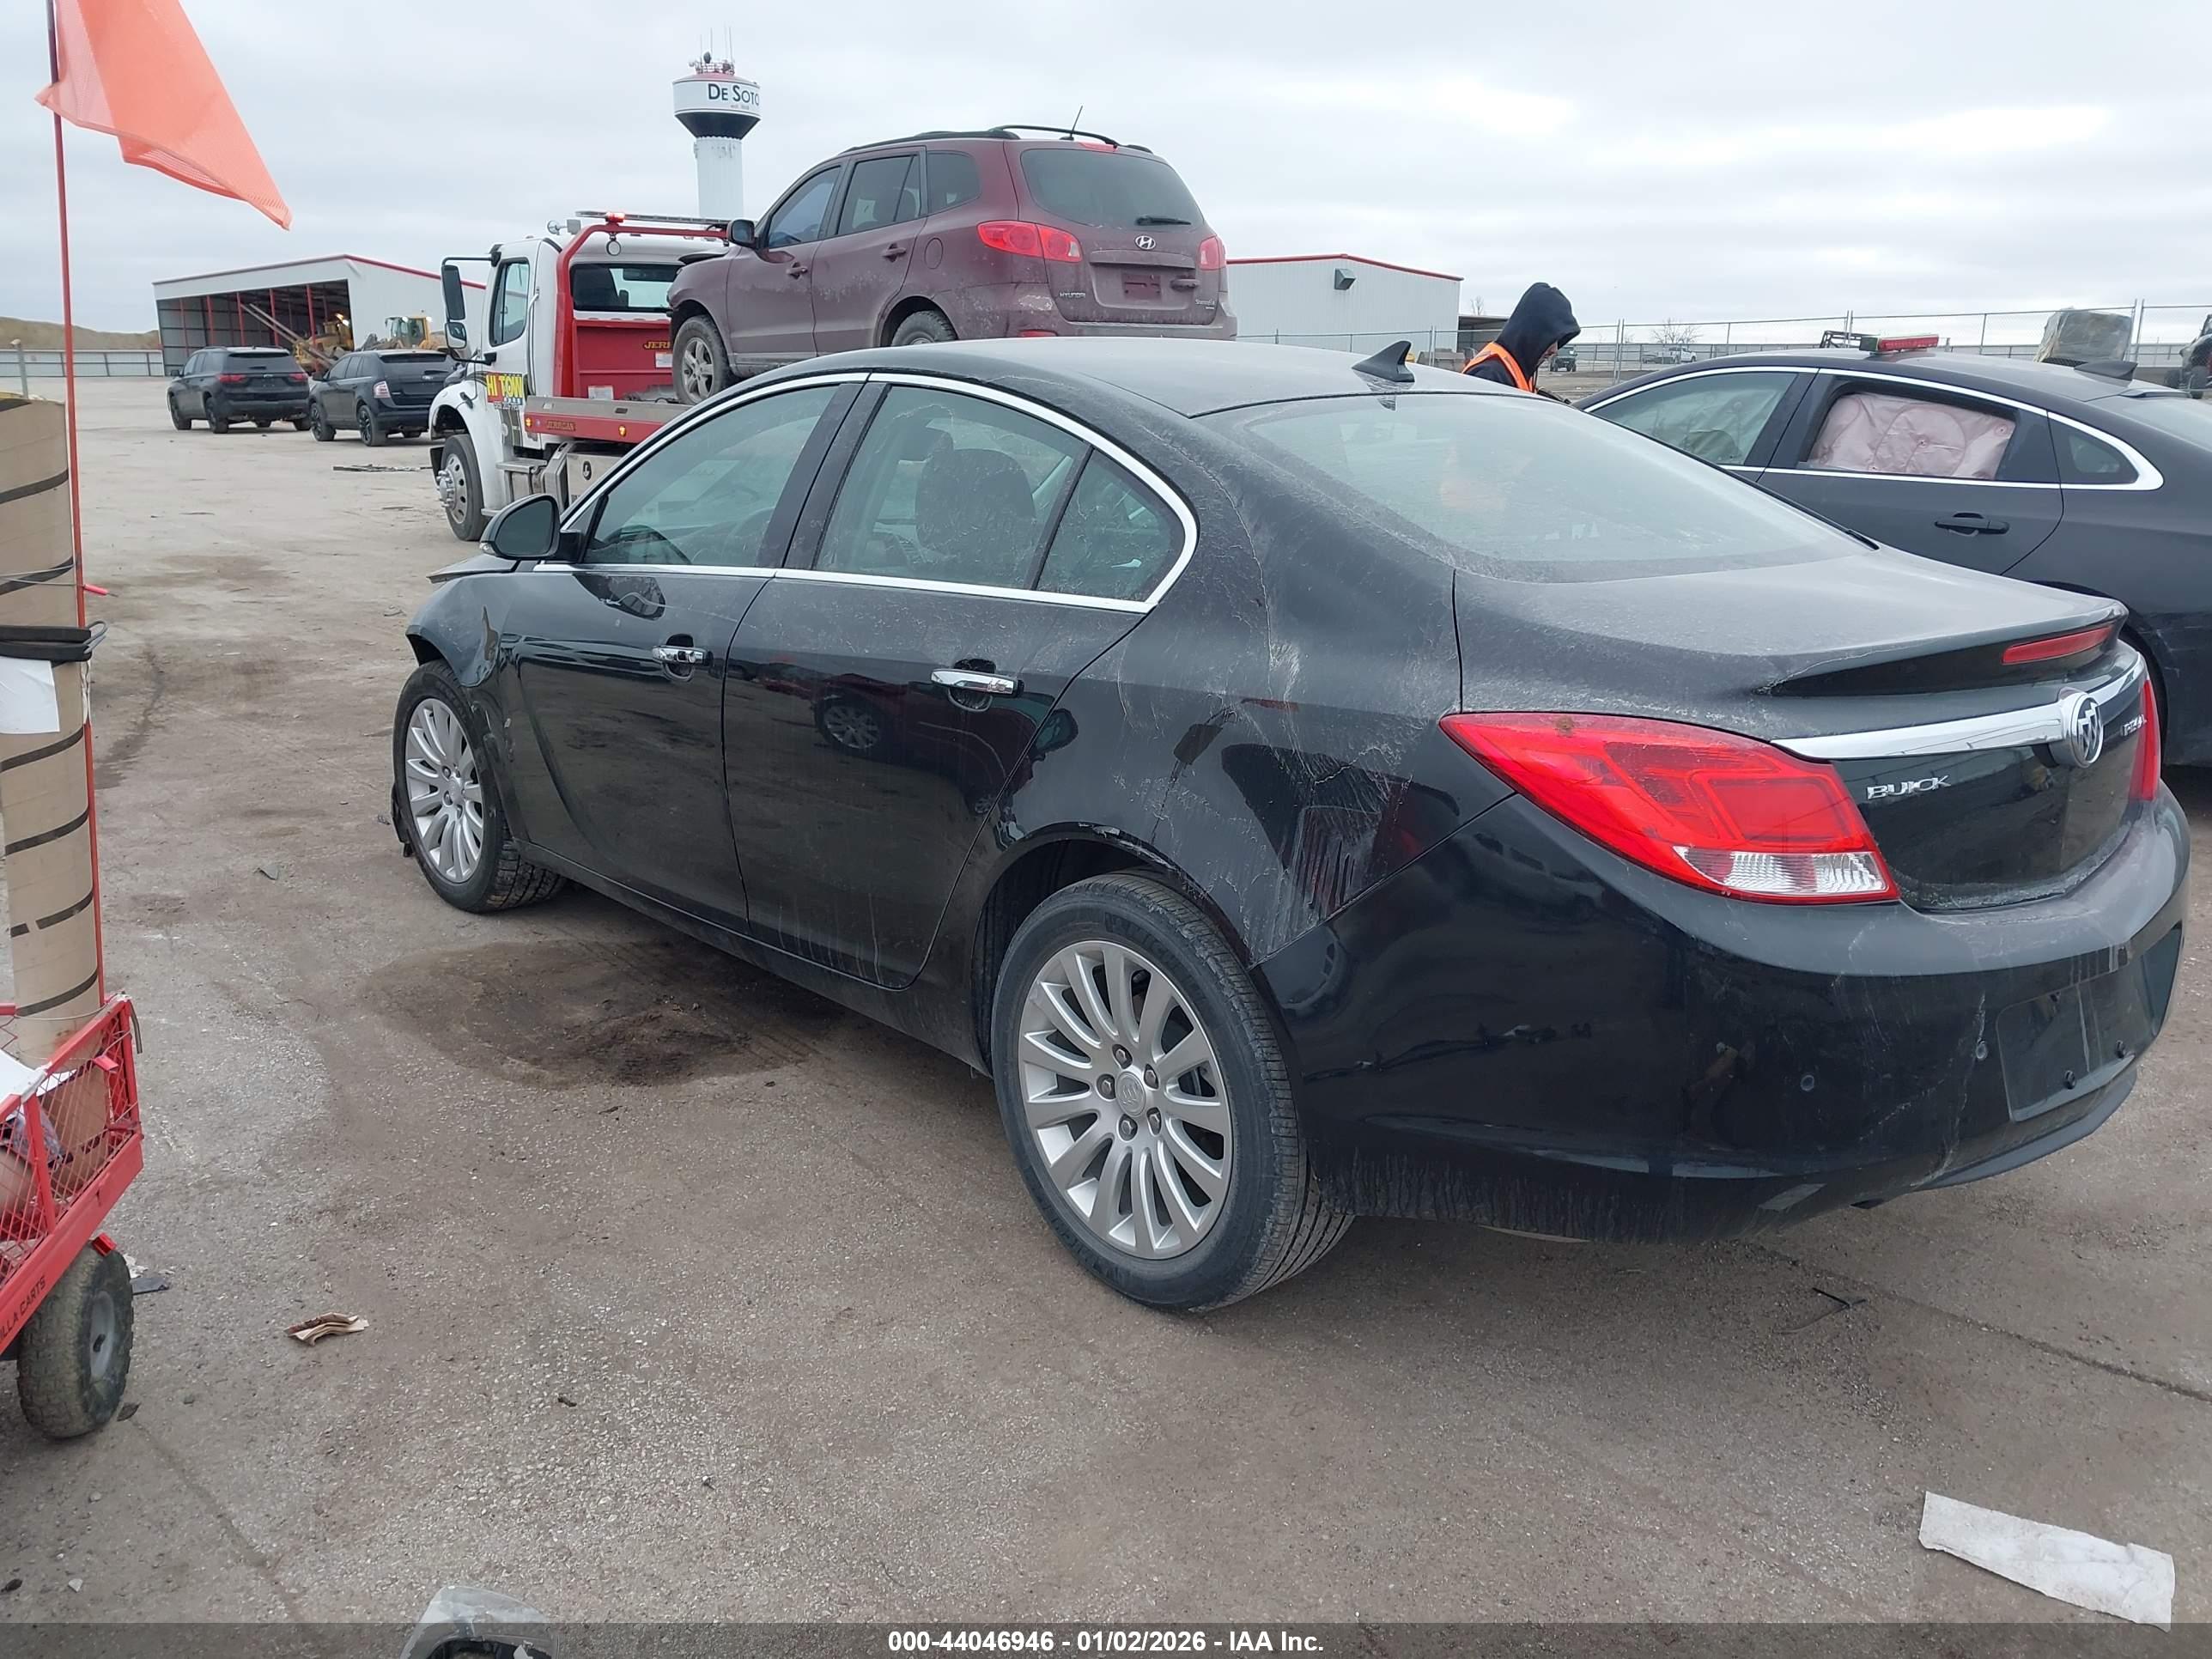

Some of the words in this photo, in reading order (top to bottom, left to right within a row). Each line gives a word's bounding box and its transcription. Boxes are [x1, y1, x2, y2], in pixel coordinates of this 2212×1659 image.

[486, 374, 498, 397] HI
[498, 374, 523, 398] TOW
[1867, 775, 1952, 800] BUICK
[20, 1274, 46, 1316] CARTS
